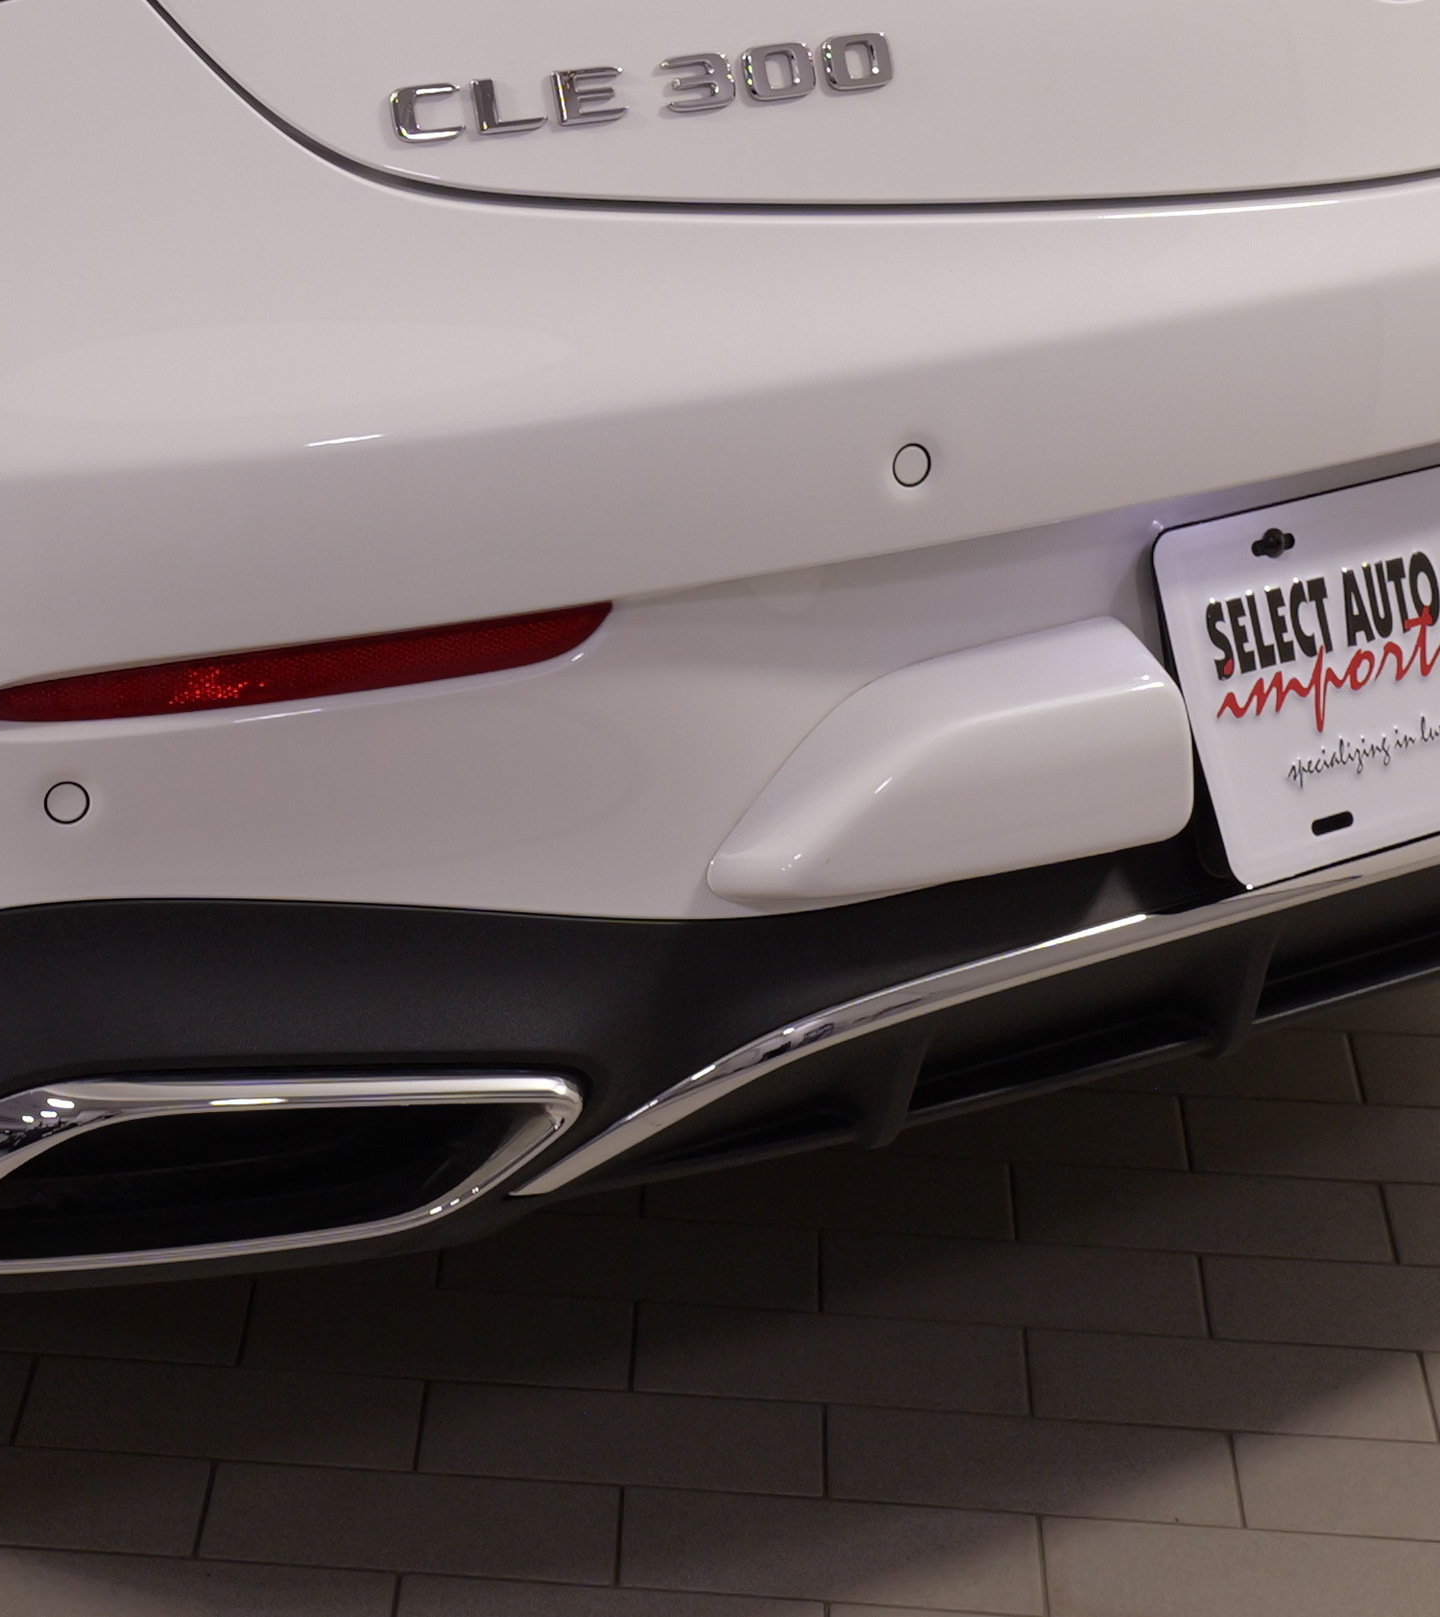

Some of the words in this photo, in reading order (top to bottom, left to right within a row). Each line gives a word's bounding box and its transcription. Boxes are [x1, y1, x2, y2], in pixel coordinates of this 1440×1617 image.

[389, 67, 629, 143] CLE
[660, 32, 894, 112] 300
[1206, 576, 1333, 681] SELECT
[1342, 551, 1440, 647] AUTO
[1287, 735, 1391, 787] specializing
[1394, 726, 1416, 749] in
